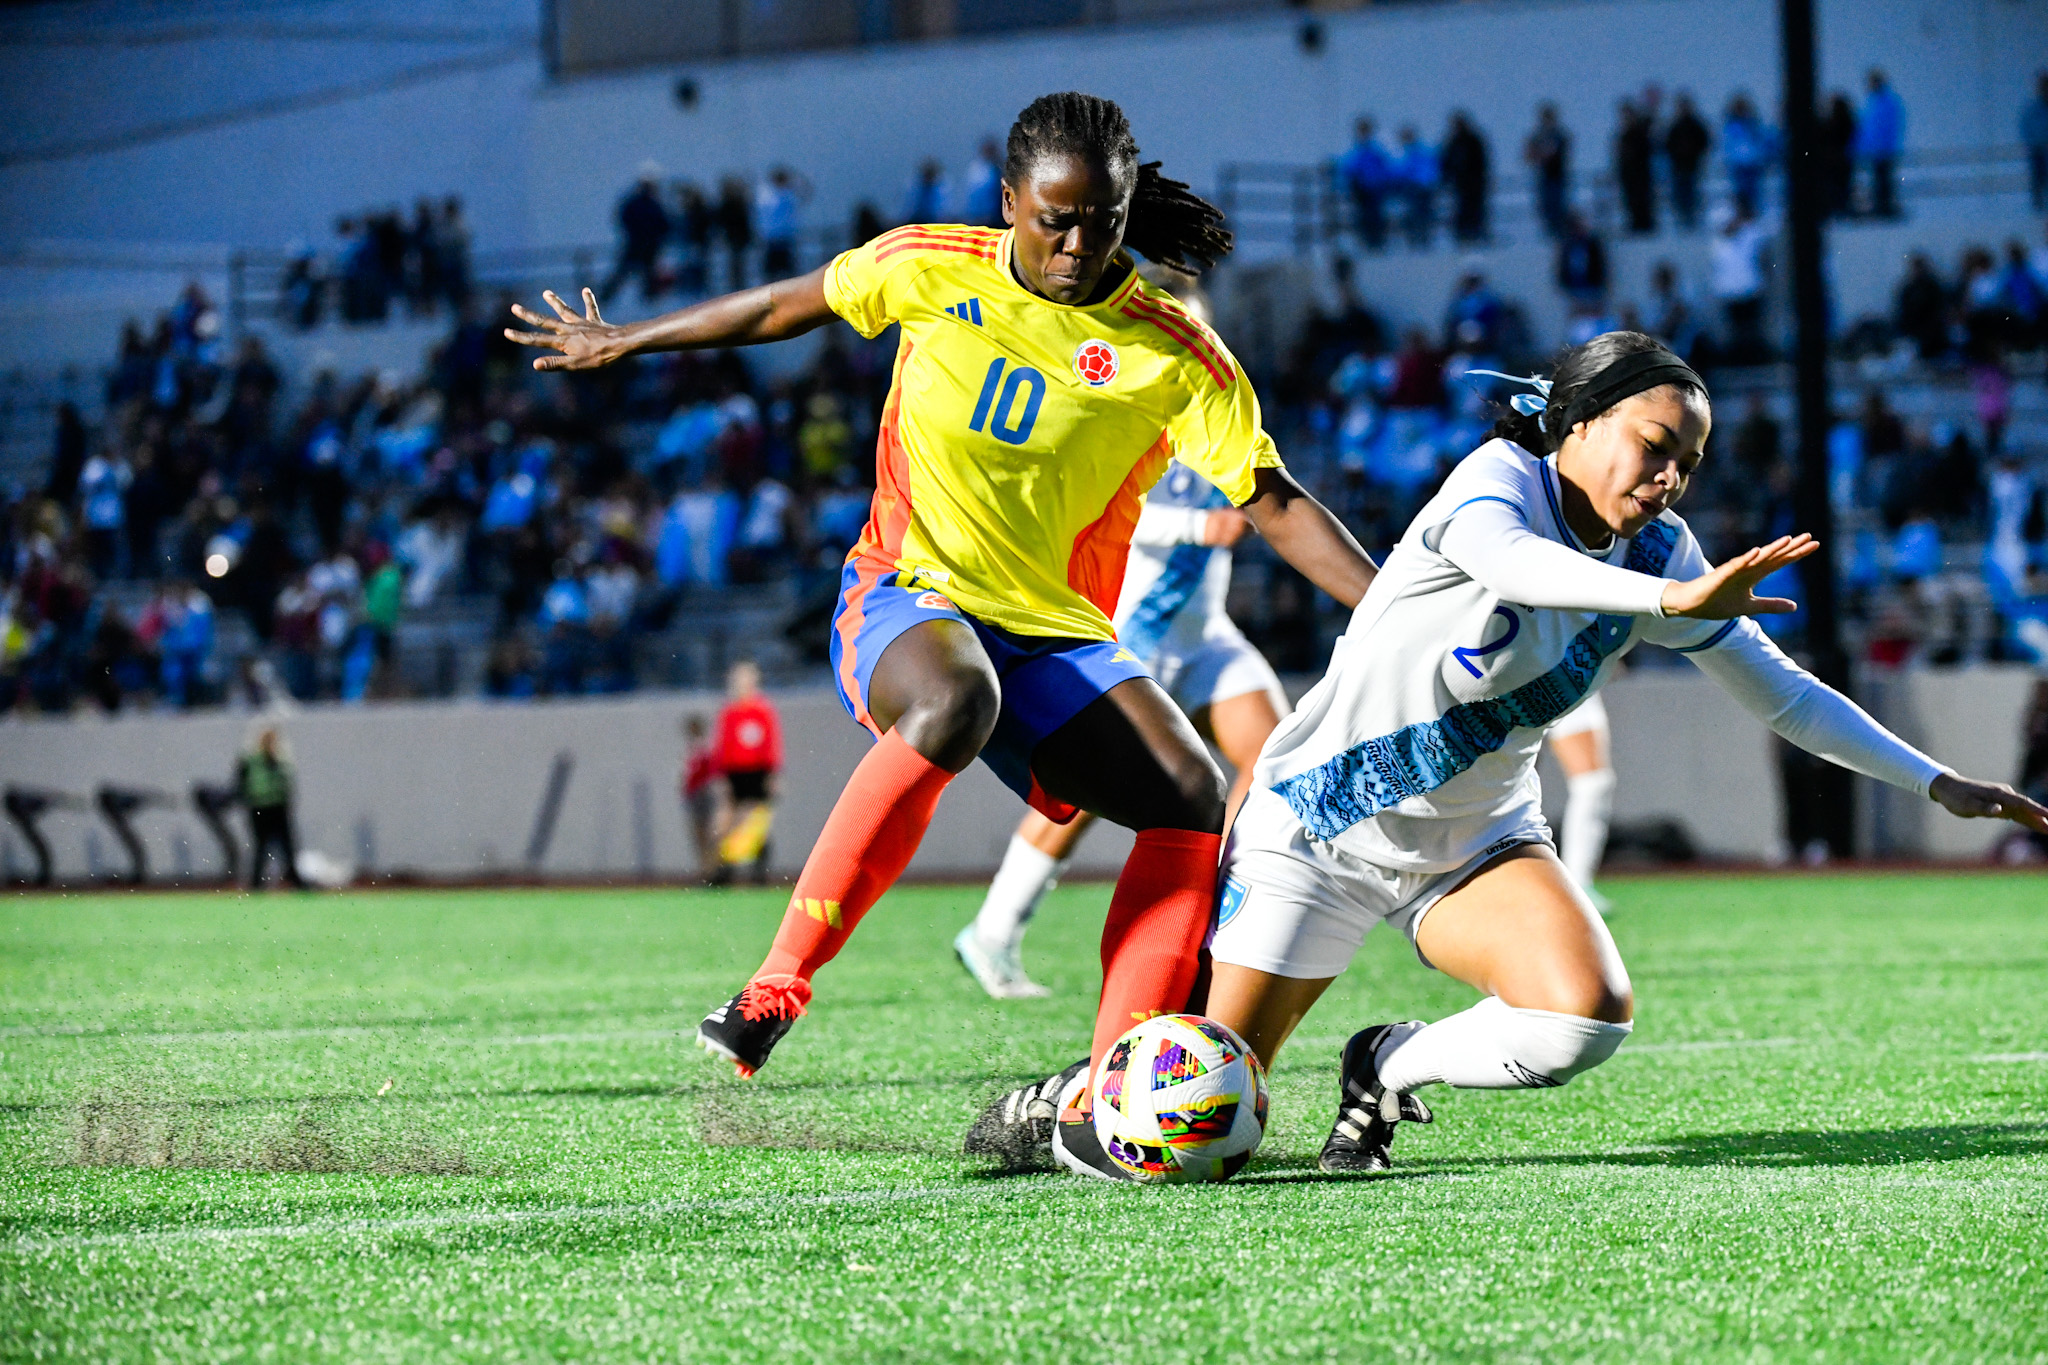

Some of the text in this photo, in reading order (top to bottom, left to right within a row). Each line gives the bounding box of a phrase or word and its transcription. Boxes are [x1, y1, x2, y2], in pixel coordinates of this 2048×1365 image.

[968, 357, 1046, 445] 10
[1452, 606, 1520, 679] 2
[1486, 838, 1517, 855] umbro
